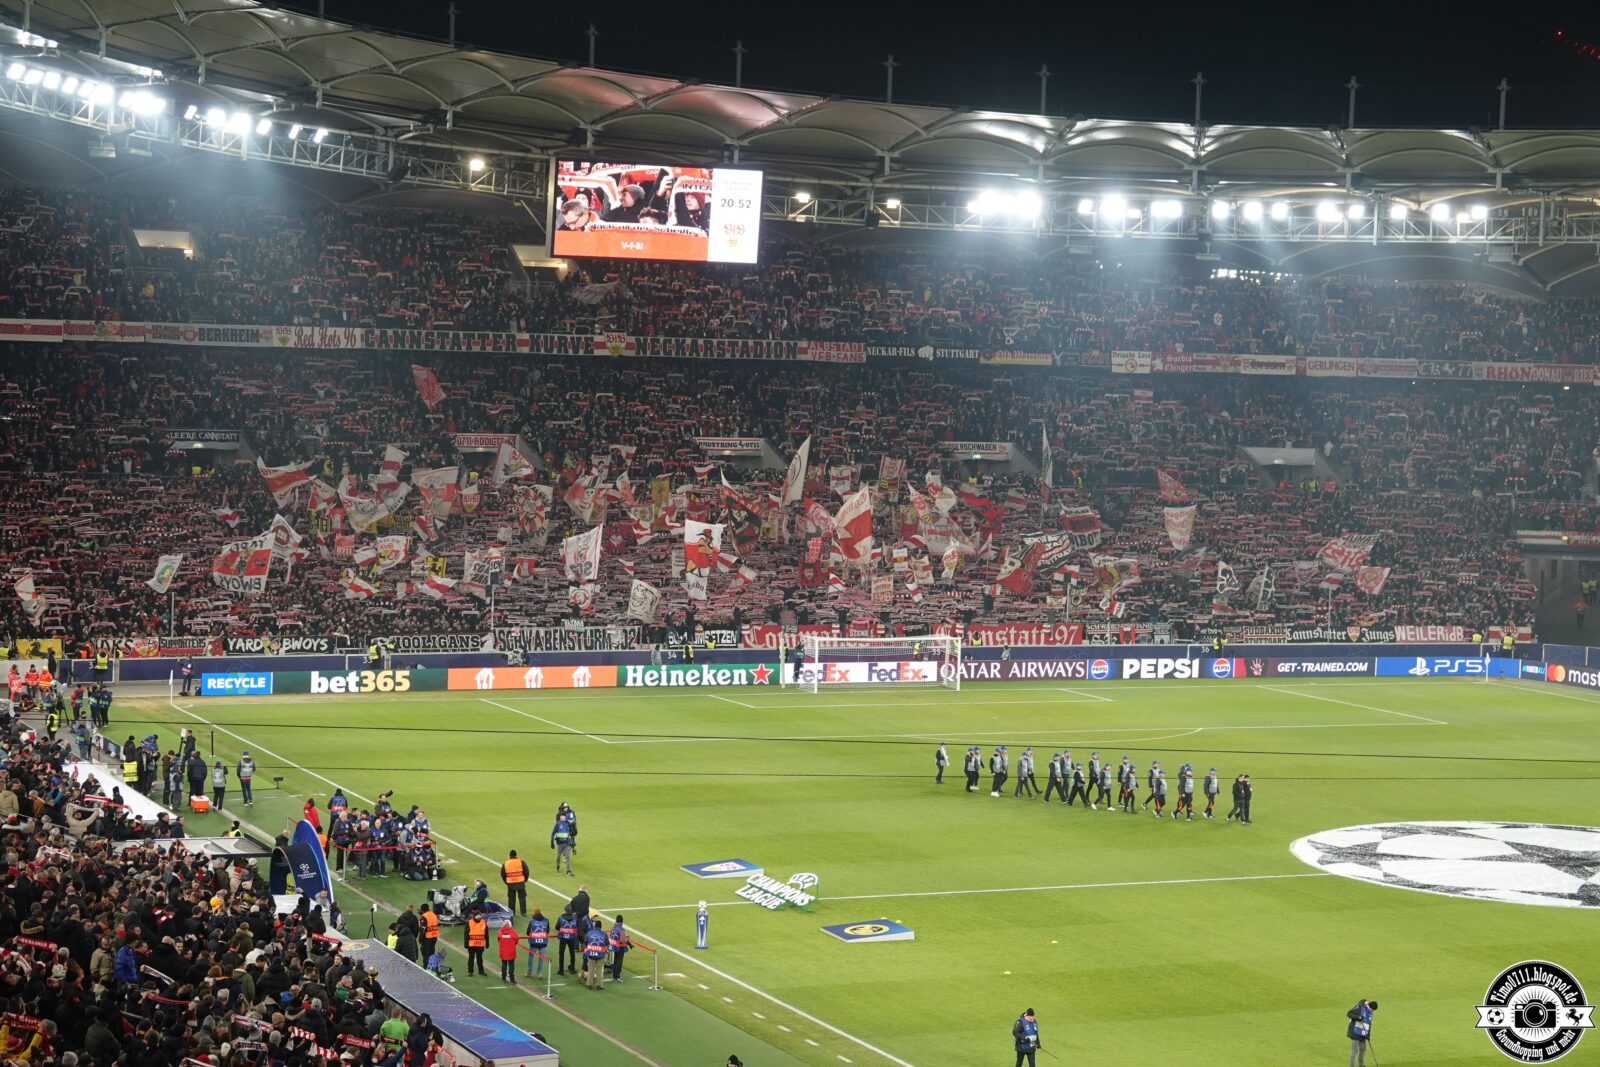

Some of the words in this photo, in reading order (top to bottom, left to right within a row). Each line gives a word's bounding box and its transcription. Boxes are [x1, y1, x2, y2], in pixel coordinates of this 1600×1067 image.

[721, 198, 752, 208] 20:52
[198, 327, 260, 343] BERKHEIM
[294, 326, 315, 347] Red
[317, 325, 341, 348] Hots
[343, 328, 357, 346] 96
[364, 329, 517, 352] CANNSTATTER
[529, 333, 595, 356] KURVE
[635, 337, 799, 360] NECKARSTADION
[808, 341, 866, 350] ALBSTADT
[866, 345, 915, 357] NECKAR-FILS
[936, 348, 979, 359] STUTTGART
[811, 351, 865, 362] VFB-FANS
[1532, 367, 1562, 382] DONAU
[1573, 368, 1594, 382] RIES
[1054, 624, 1079, 646] 97
[1361, 627, 1395, 643] Jungs
[227, 638, 262, 652] YARD
[283, 638, 329, 653] BWOYS
[667, 651, 677, 659] 34
[868, 661, 923, 682] FedEx
[940, 662, 1001, 680] QATAR
[1009, 661, 1085, 678] AIRWAYS
[1122, 658, 1199, 679] PEPSI
[1277, 662, 1368, 673] GET-TRAINED.COM
[1434, 659, 1483, 673] PS5
[310, 670, 410, 693] bet365
[625, 664, 748, 687] Heineken
[207, 678, 266, 690] RECYCLE
[735, 884, 786, 910] LEAGUE
[747, 874, 816, 906] CHAMPIONS
